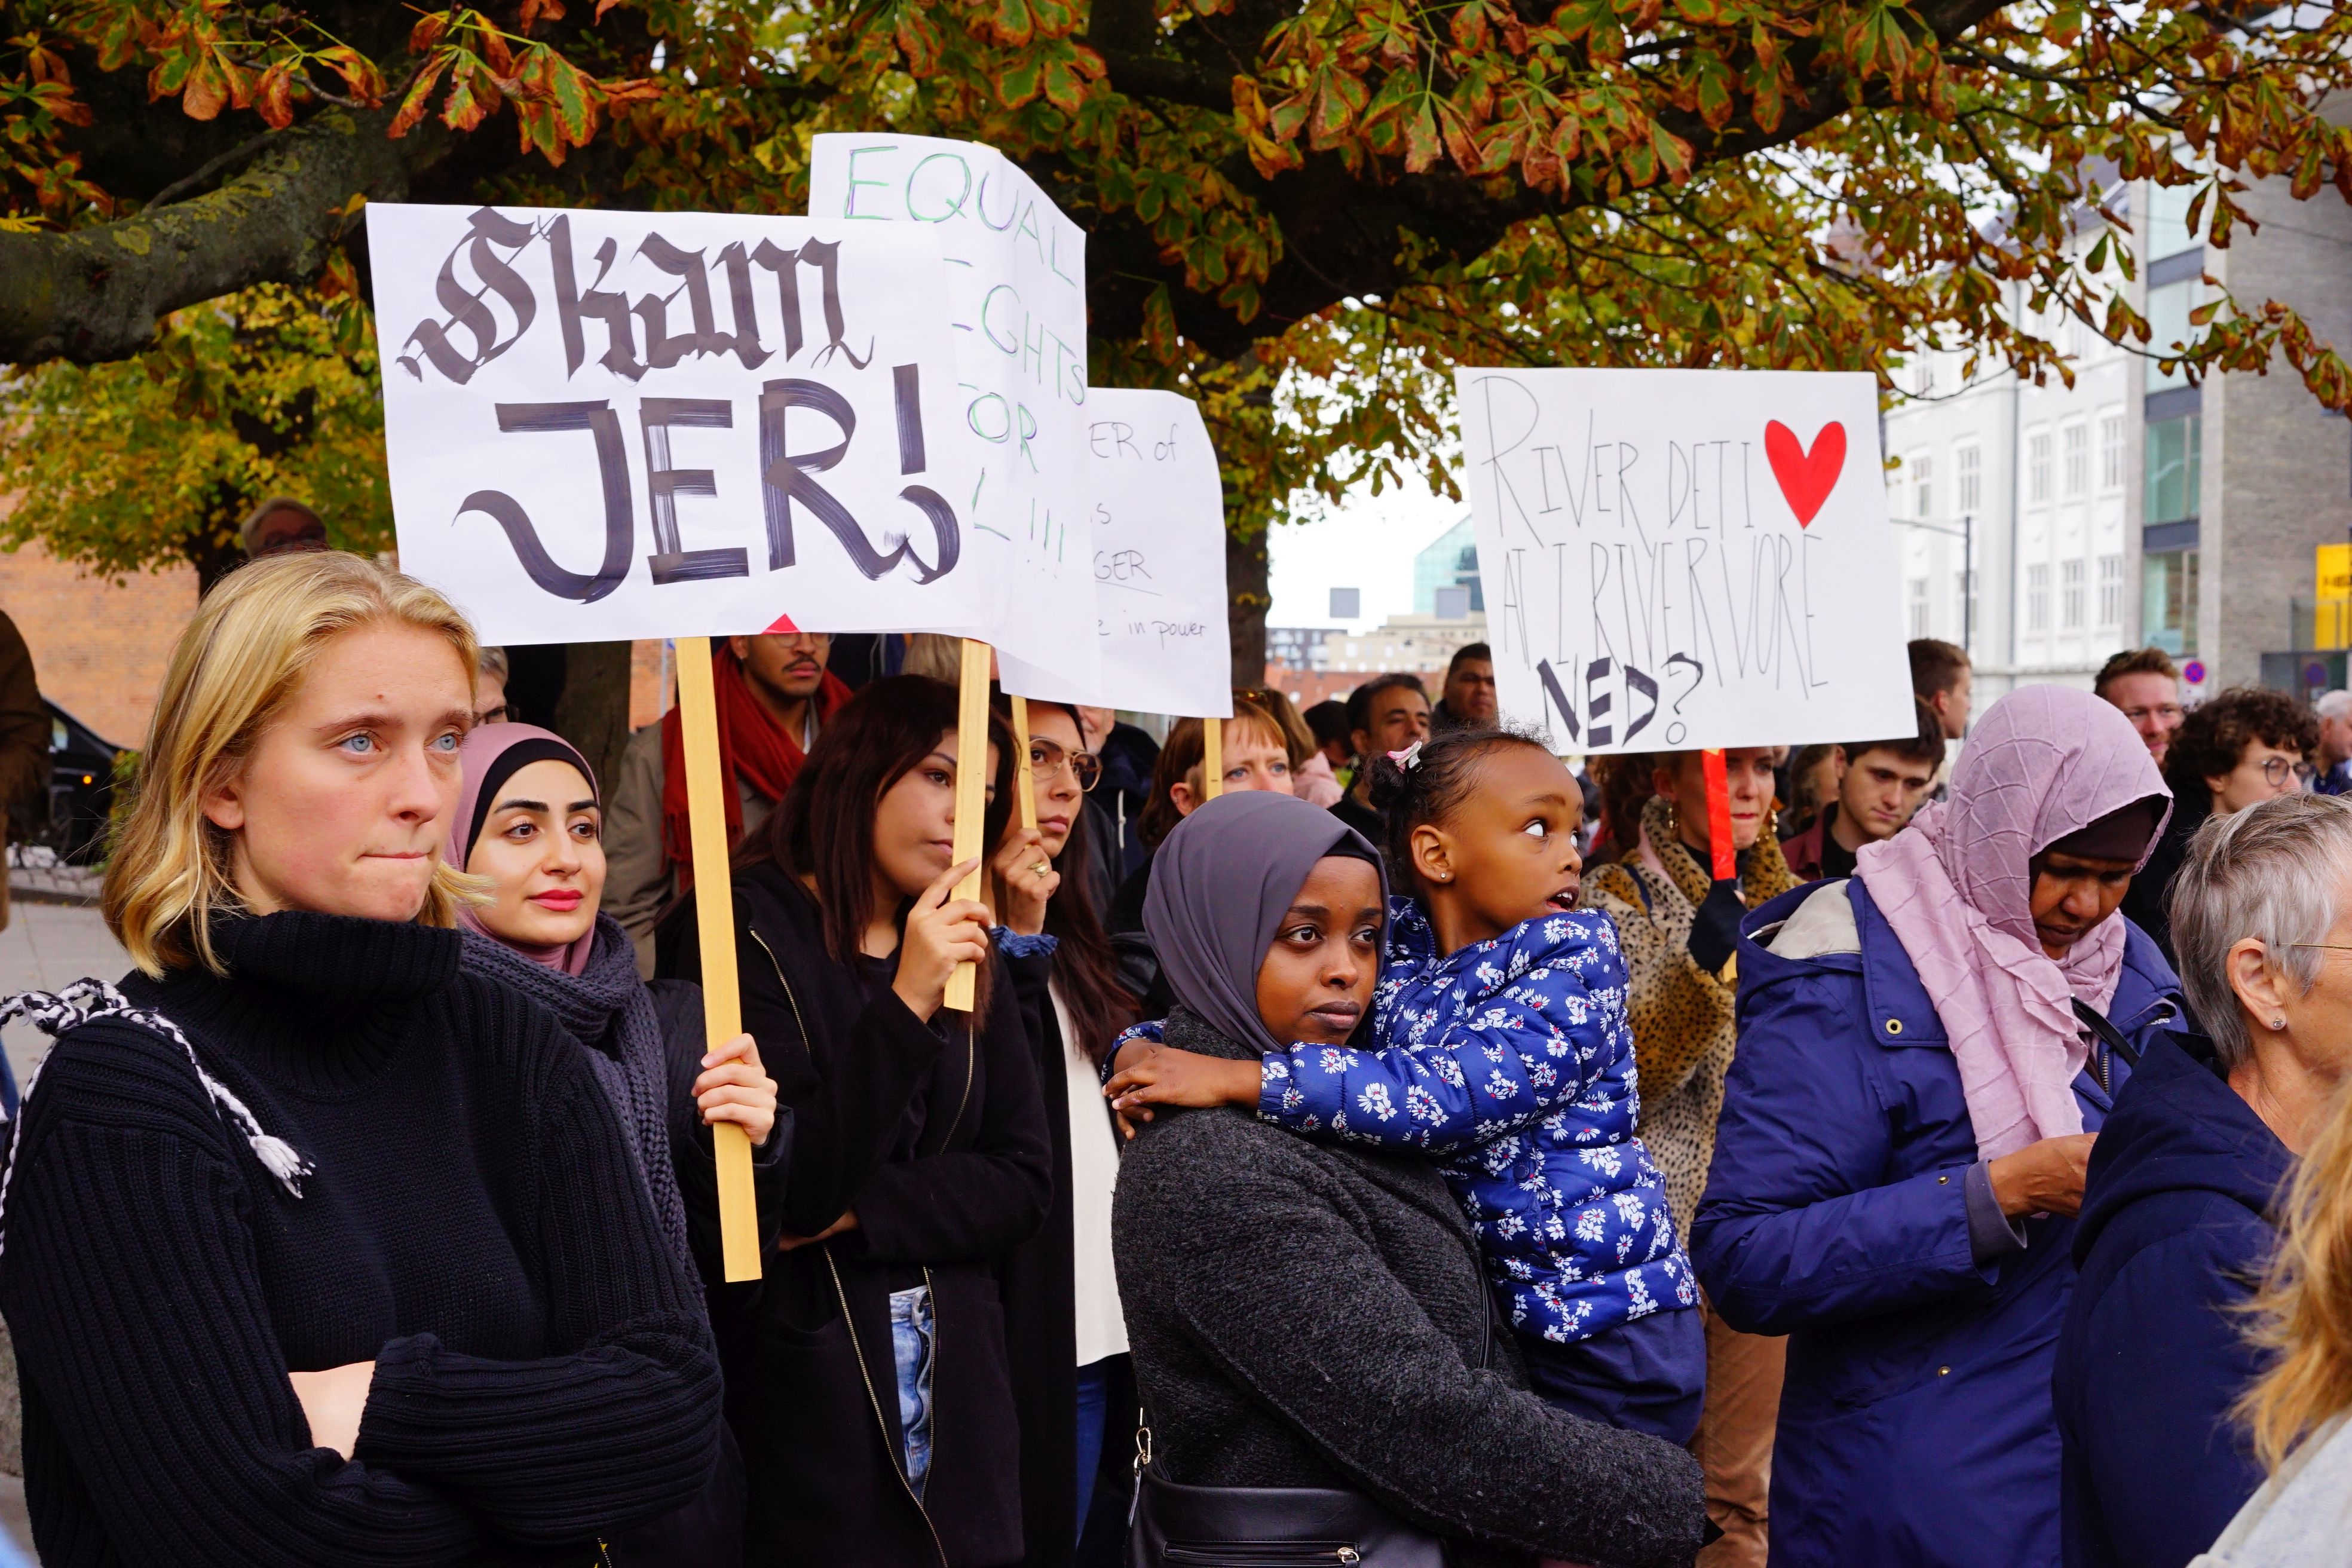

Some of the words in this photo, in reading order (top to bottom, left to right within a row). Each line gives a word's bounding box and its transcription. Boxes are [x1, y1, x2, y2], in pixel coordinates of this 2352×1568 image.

[844, 146, 1077, 288] EQUAL
[396, 206, 874, 387] Skam
[452, 363, 960, 605] JER!
[1154, 423, 1178, 462] of
[1472, 376, 1652, 558] RIVER
[1151, 620, 1206, 651] power
[1504, 549, 1530, 670] AT
[1591, 538, 1723, 688] RIVER
[1536, 651, 1704, 749] NED?
